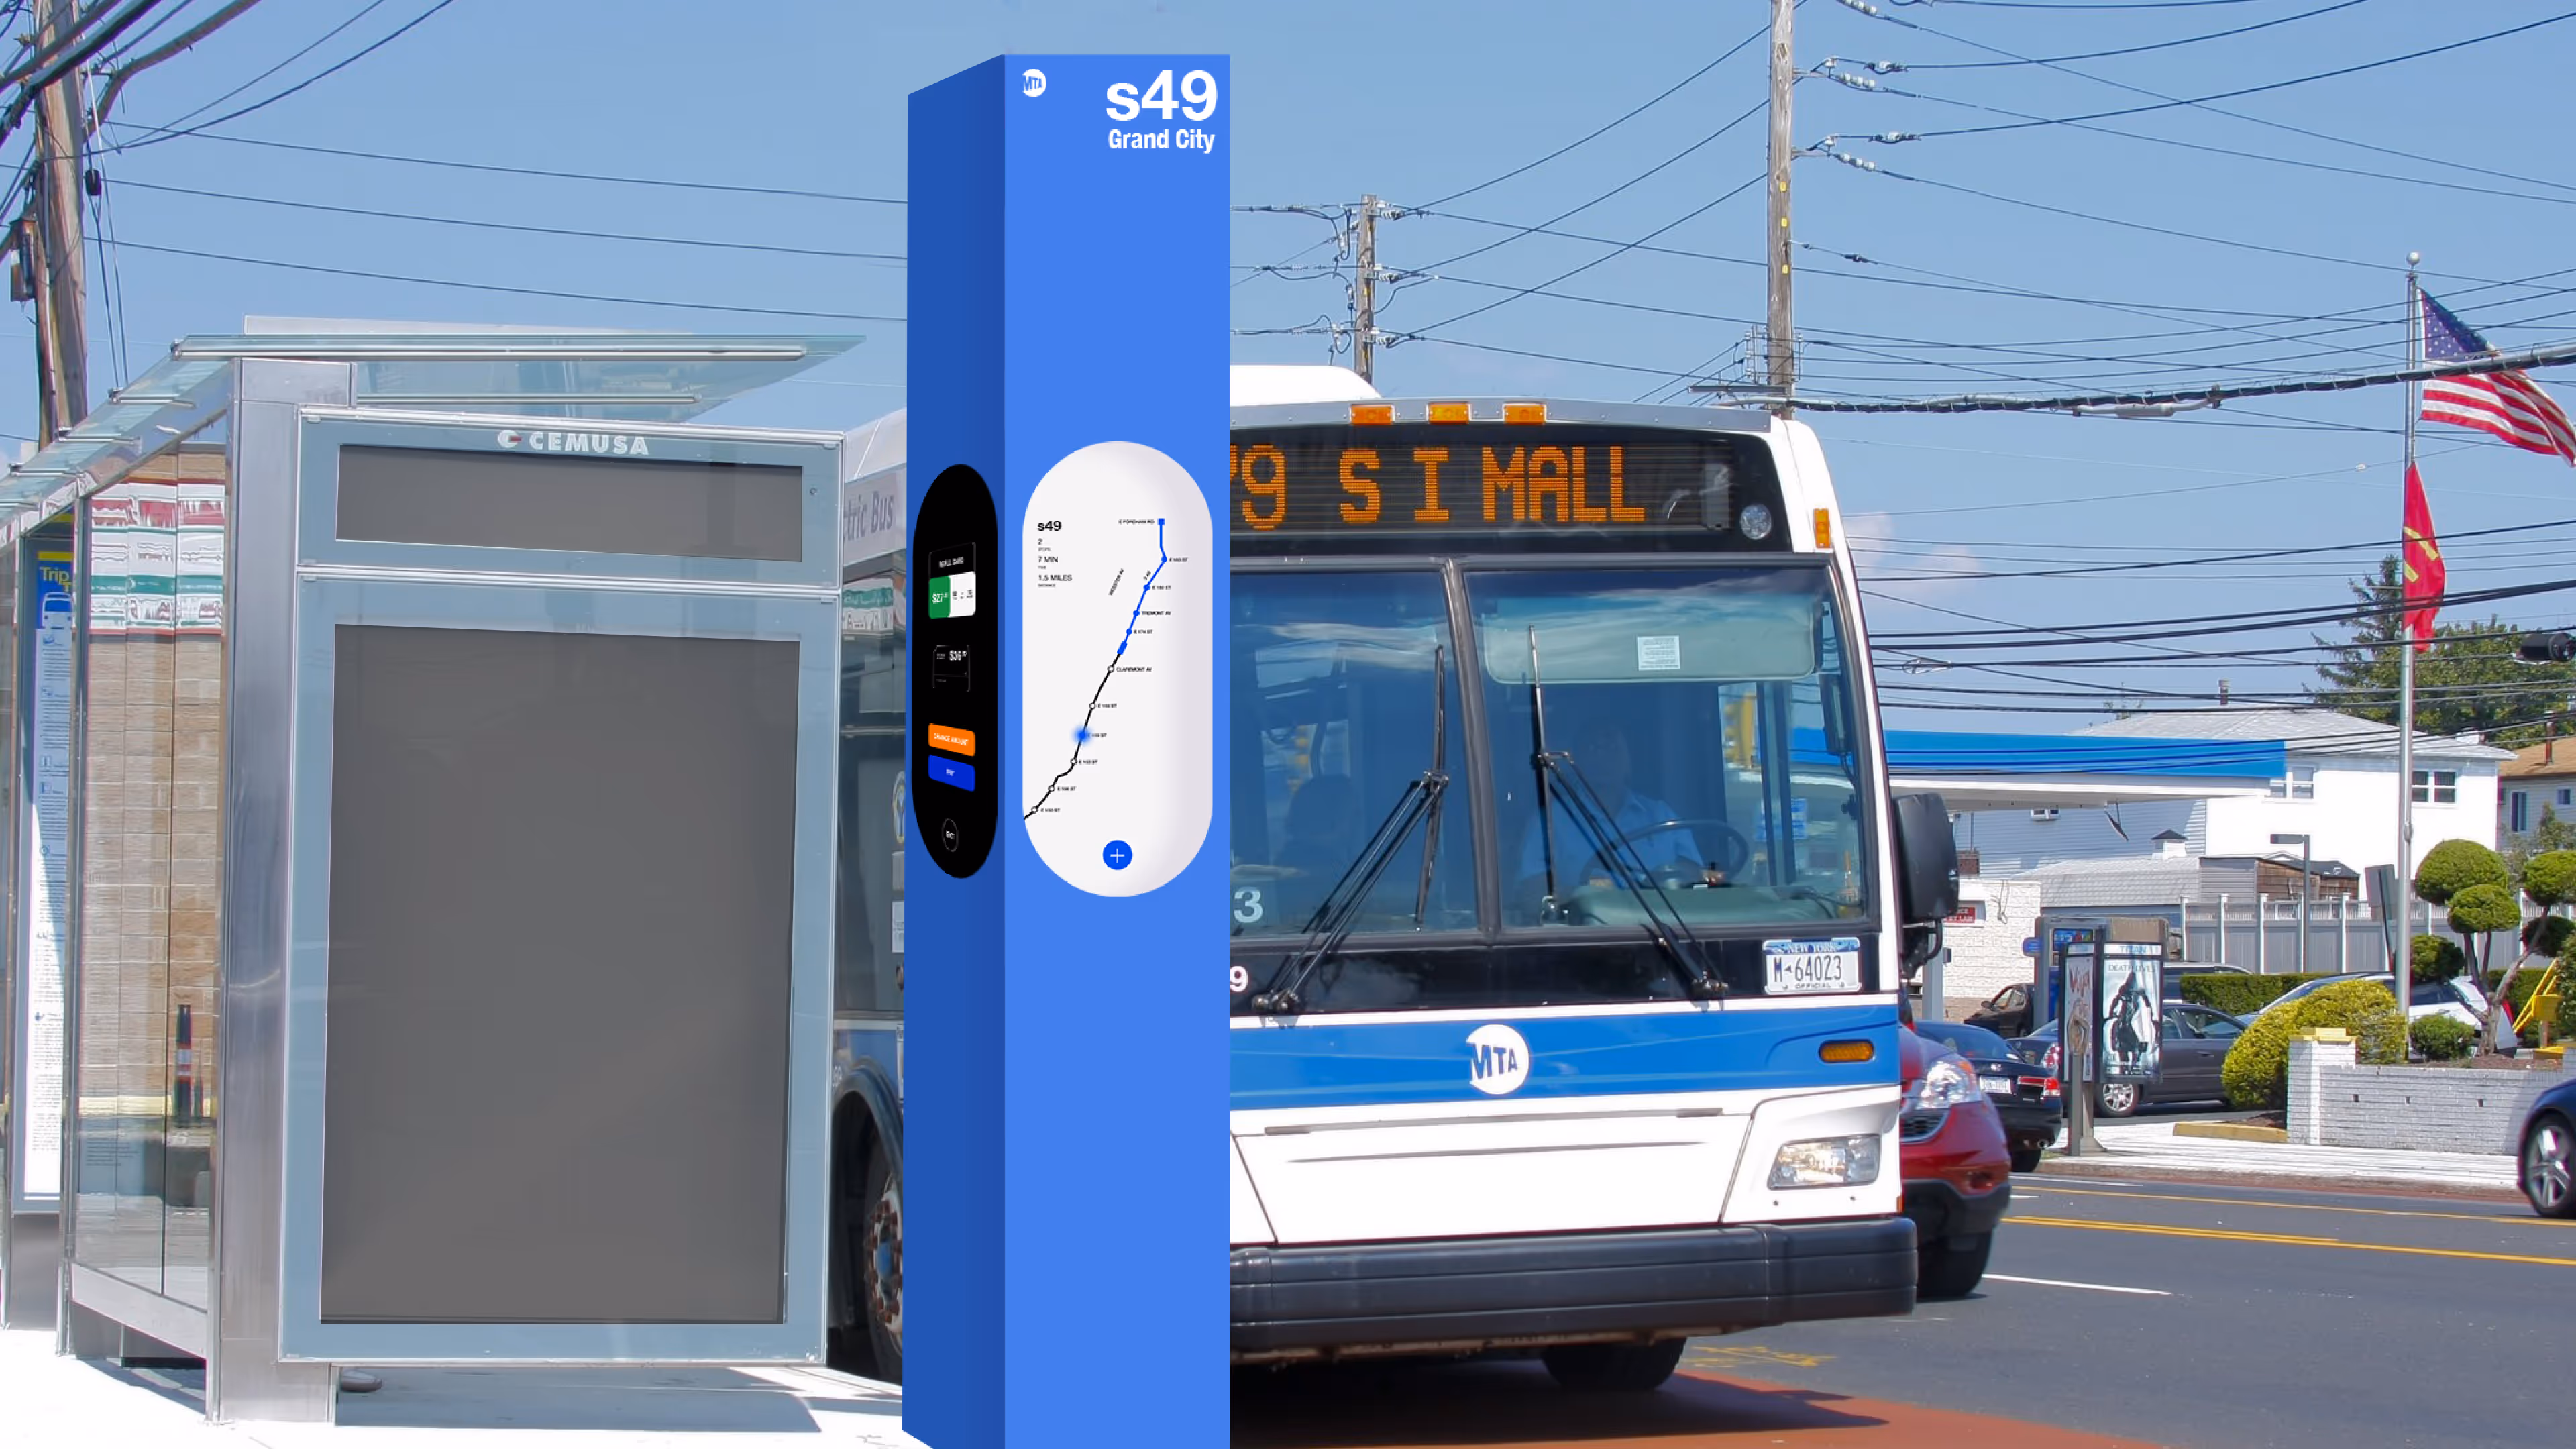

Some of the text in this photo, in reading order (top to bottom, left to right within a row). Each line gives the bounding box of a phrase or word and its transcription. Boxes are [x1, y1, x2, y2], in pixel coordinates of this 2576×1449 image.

[1106, 70, 1218, 121] s49
[1108, 129, 1215, 154] Grand City
[529, 431, 649, 456] CEMUSA
[1230, 445, 1646, 531] 9 S I MALL
[871, 490, 894, 533] Bus
[1037, 521, 1061, 531] s49
[39, 566, 70, 585] Trip
[1234, 887, 1263, 923] 3
[1467, 1042, 1517, 1079] MTA
